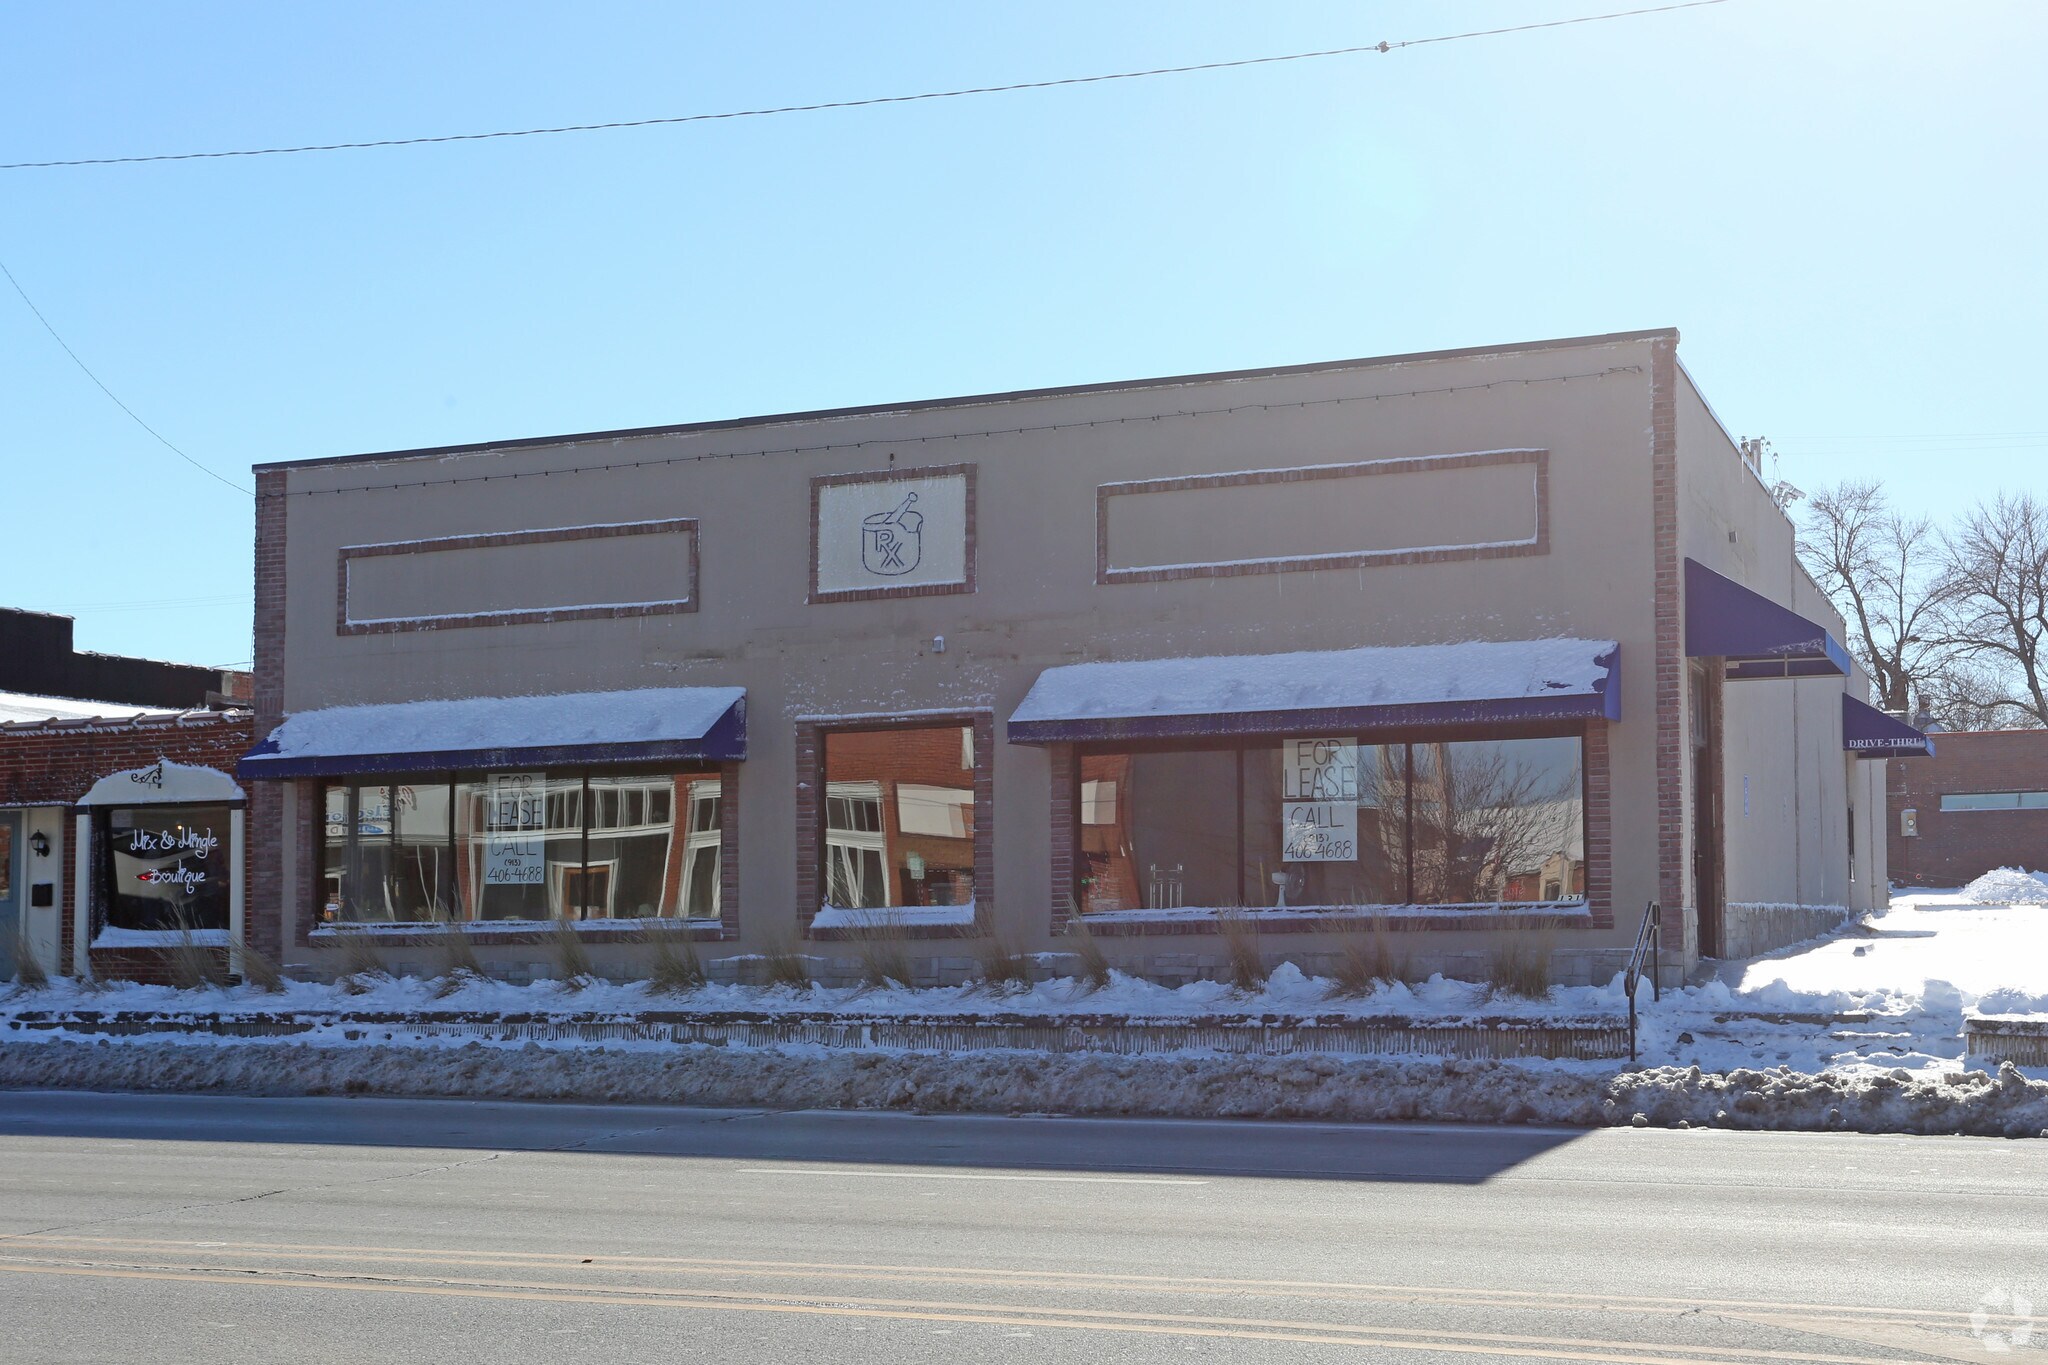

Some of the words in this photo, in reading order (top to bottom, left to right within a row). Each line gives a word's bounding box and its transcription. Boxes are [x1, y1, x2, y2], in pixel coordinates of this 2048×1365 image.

[1297, 740, 1342, 766] FOR
[1849, 738, 1922, 748] DRIVE-THRU
[499, 775, 533, 799] FOR
[1284, 766, 1355, 797] LEASE
[488, 800, 541, 825] LEASE
[1291, 806, 1344, 828] CALL
[131, 829, 157, 850] Mix
[160, 830, 175, 849] &
[178, 827, 218, 858] Mingle
[491, 836, 536, 856] CALL
[1285, 840, 1352, 858] 406-4688
[150, 859, 206, 893] Boutique
[488, 866, 542, 882] 406-4688
